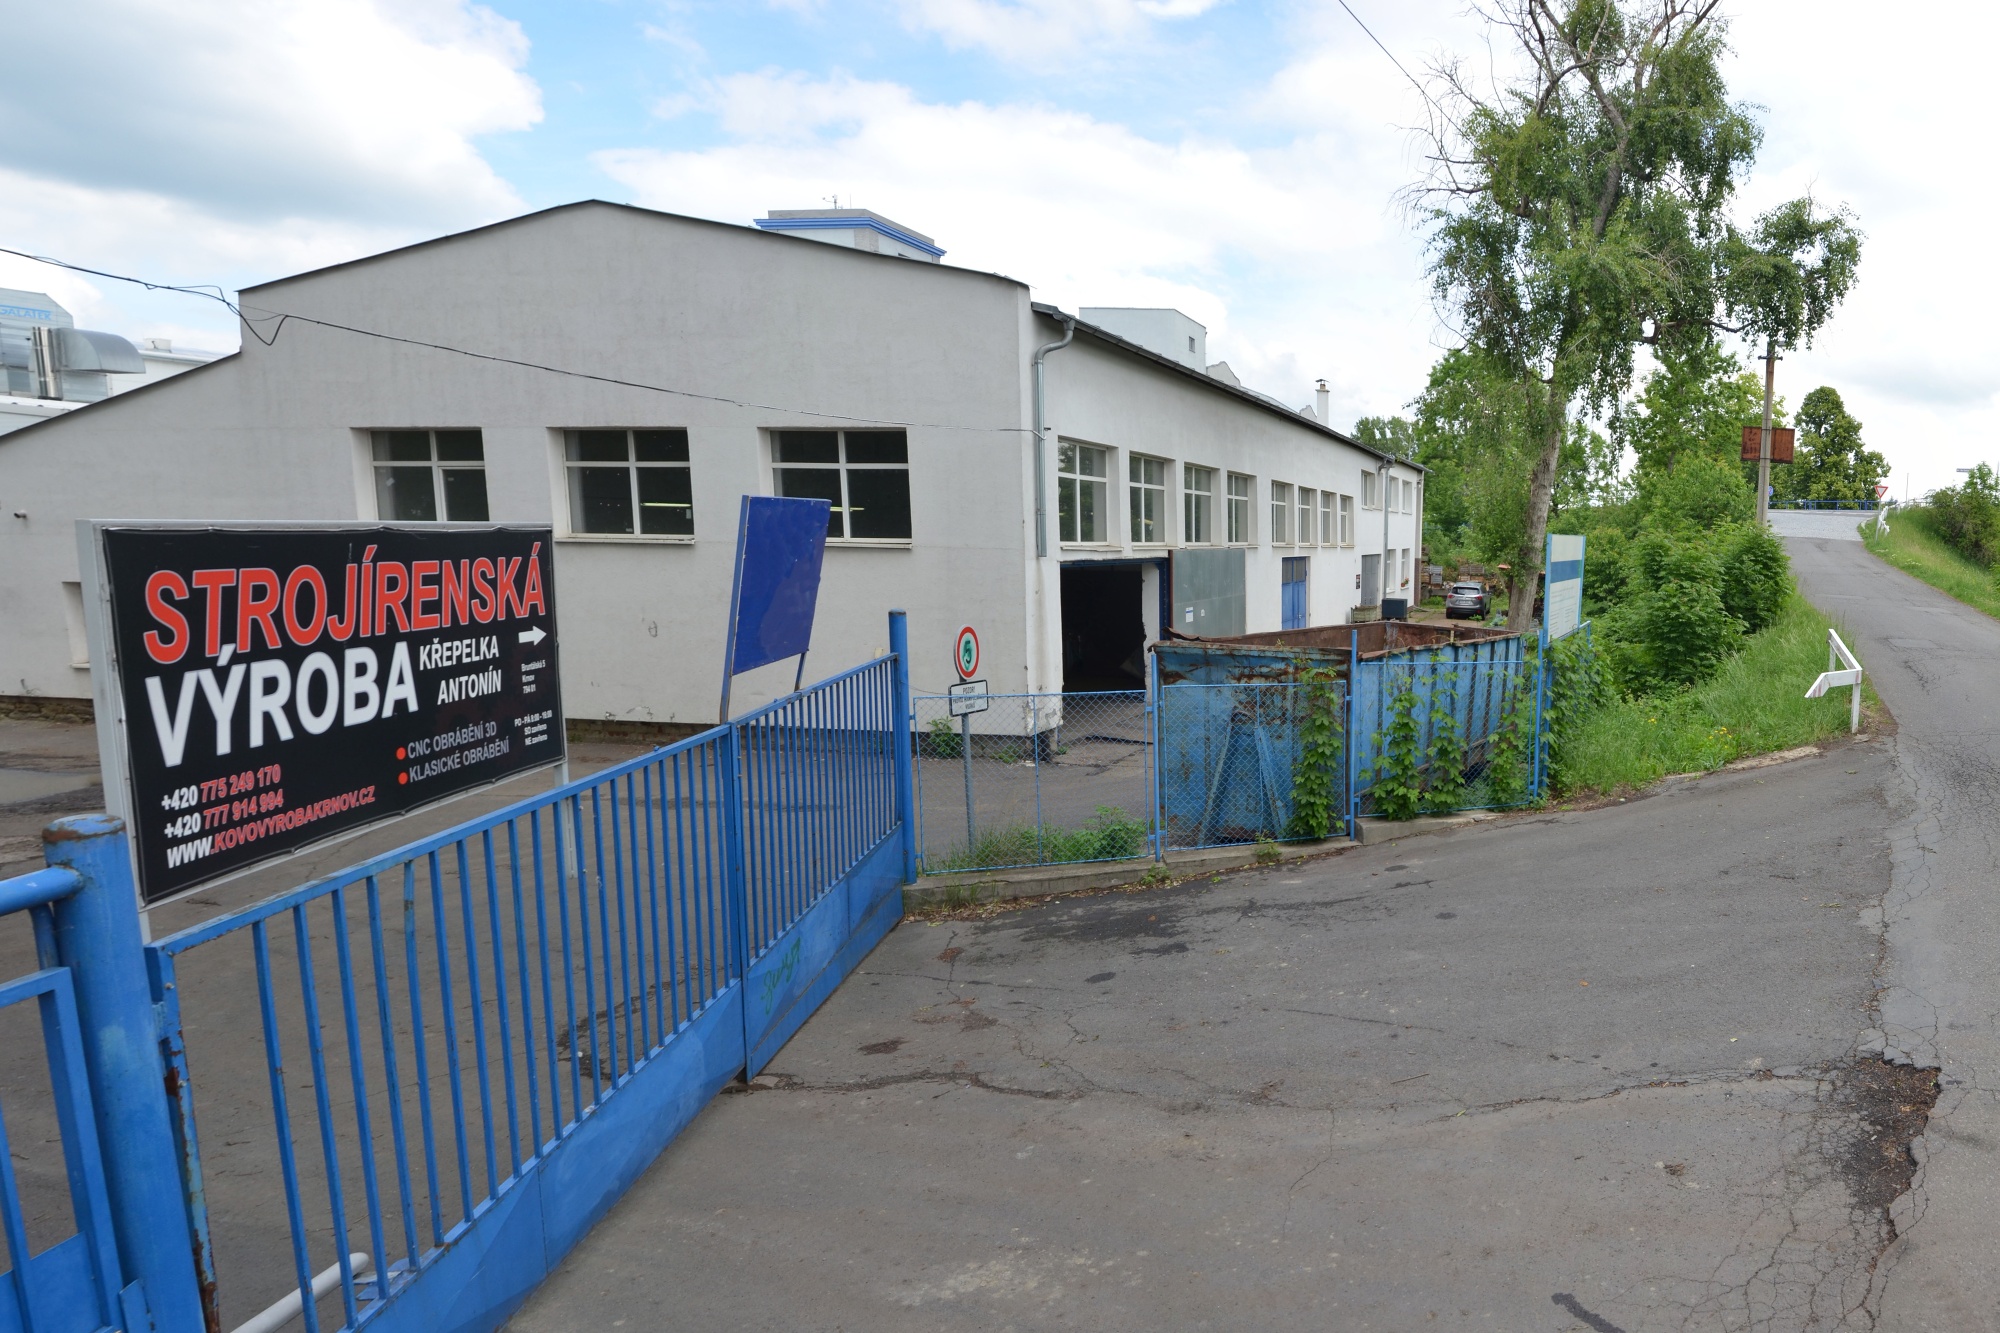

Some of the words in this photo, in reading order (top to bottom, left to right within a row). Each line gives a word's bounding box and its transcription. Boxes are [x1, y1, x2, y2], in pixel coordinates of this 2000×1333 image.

[143, 542, 546, 664] STROJÍRENSKÁ
[419, 635, 500, 671] KŘEPELKA
[437, 665, 502, 705] ANTONÍN
[522, 674, 535, 684] Krnov
[144, 641, 419, 768] VÝROBA
[408, 738, 431, 759] CNC
[433, 721, 484, 751] OBRÁBĚNÍ
[485, 721, 497, 737] 3D
[525, 737, 532, 746] NE
[532, 734, 548, 744] zavřeno
[532, 723, 547, 734] zavřeno
[409, 750, 461, 783] KLASICKÉ
[463, 736, 510, 766] OBRÁBĚNÍ
[161, 785, 199, 811] +420
[200, 777, 228, 803] 775
[229, 770, 255, 796] 249
[257, 763, 281, 788] 170
[164, 812, 201, 839] +420
[203, 803, 229, 830] 777
[232, 795, 258, 821] 914
[259, 789, 284, 813] 994
